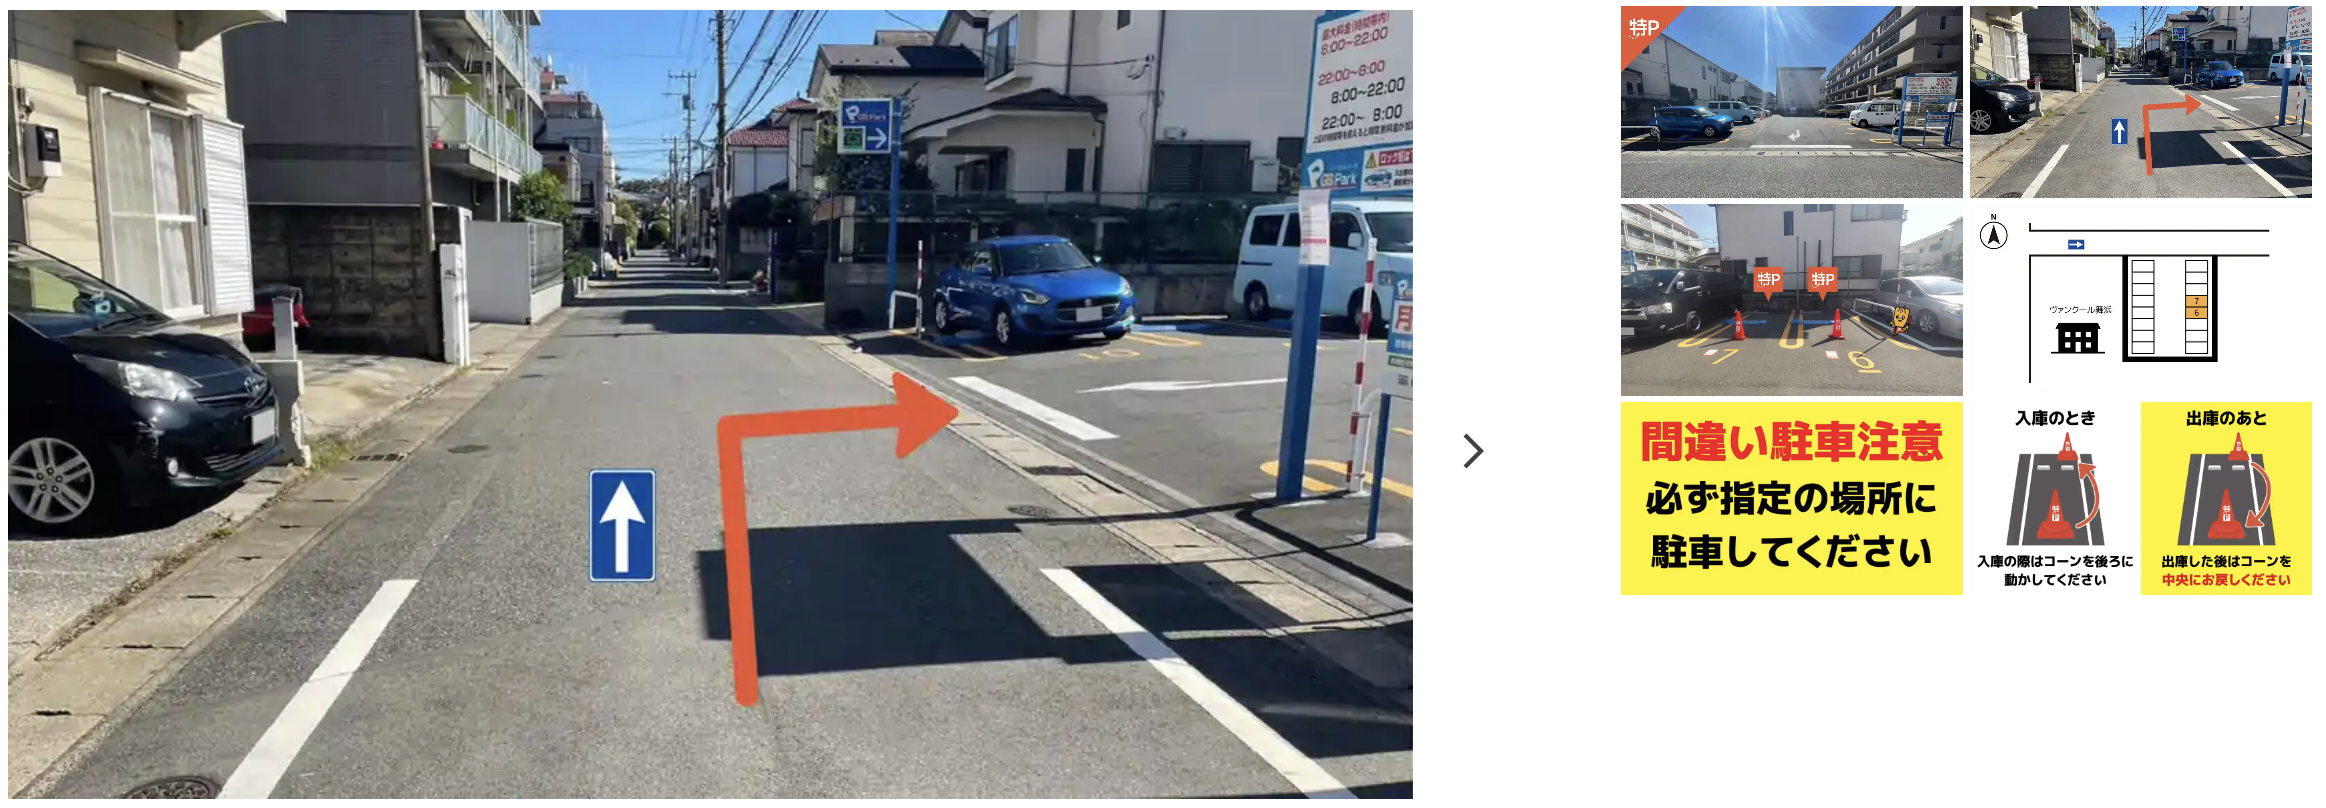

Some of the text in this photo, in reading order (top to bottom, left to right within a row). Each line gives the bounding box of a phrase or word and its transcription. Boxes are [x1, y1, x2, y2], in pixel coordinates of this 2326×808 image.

[1990, 213, 1997, 221] N
[2194, 297, 2200, 305] 7
[2194, 309, 2200, 317] 6
[2015, 410, 2095, 426] 入庫のとき
[2186, 410, 2267, 426] 出庫のあと
[1641, 420, 1944, 463] 間違い駐車注意
[1645, 480, 1936, 516] 必ず指定の場所に
[1650, 533, 1932, 570] 駐車してください
[1977, 555, 2134, 568] 入庫の際はコーンを後ろに
[2161, 555, 2292, 568] 出庫した後はコーンを
[2004, 573, 2107, 587] 動かしてください
[2162, 573, 2291, 587] 中央にお戻しください
